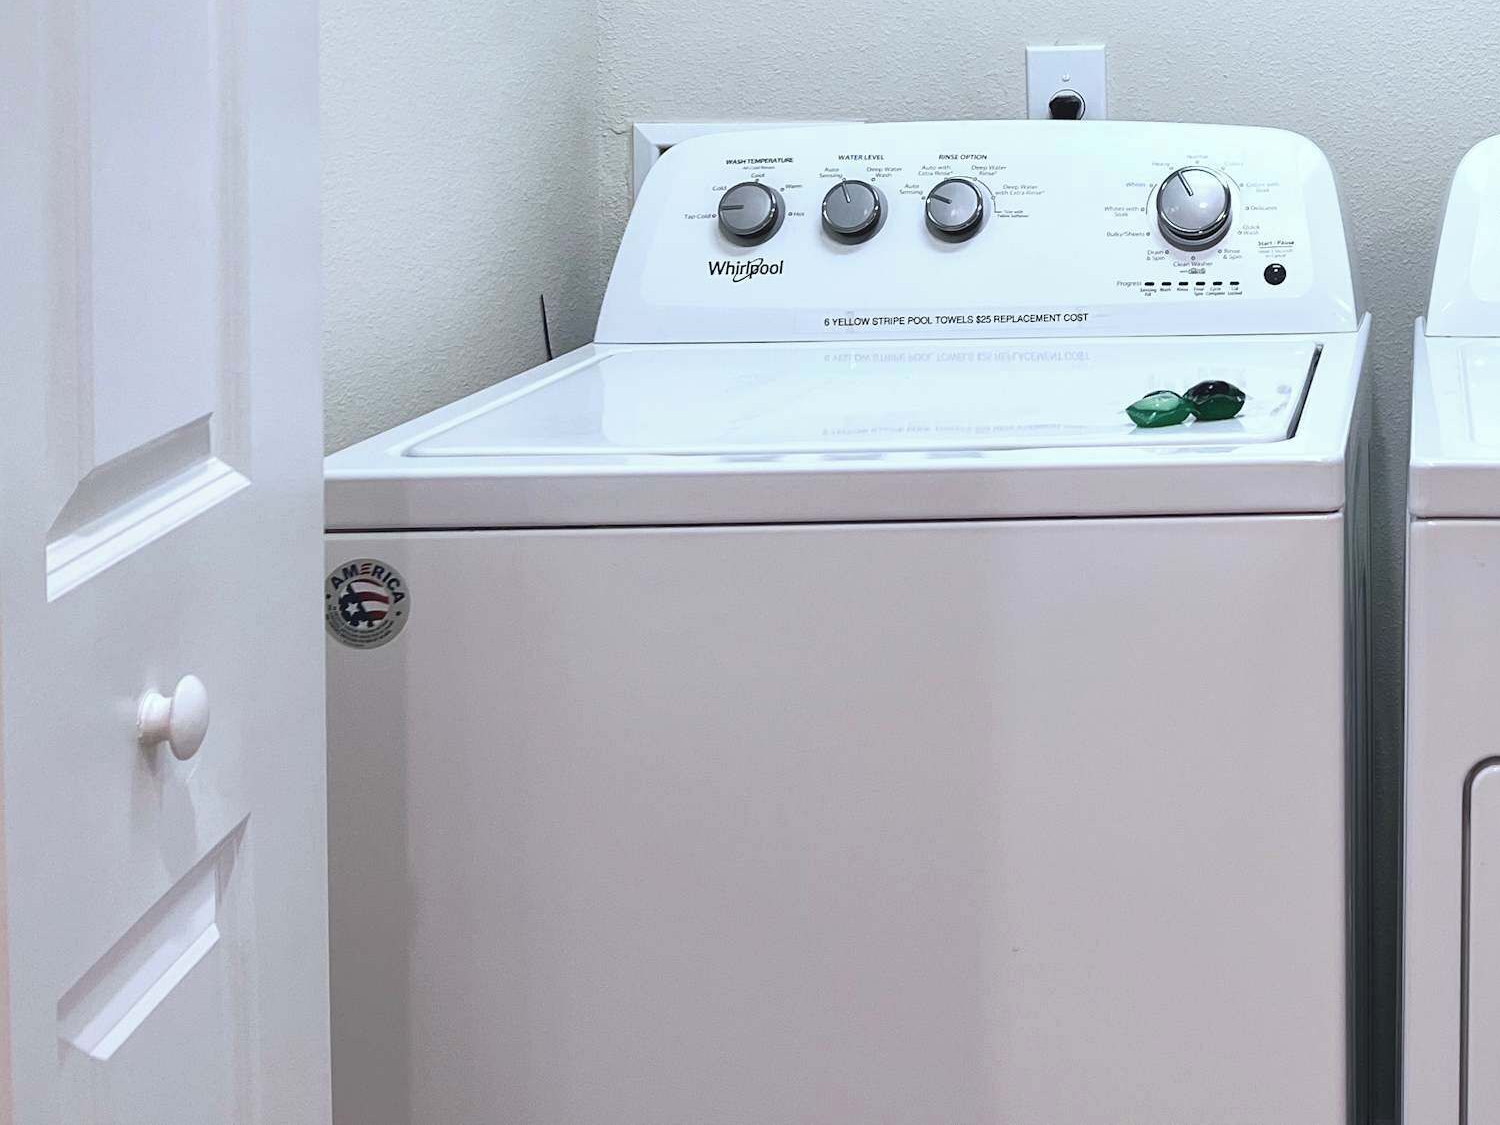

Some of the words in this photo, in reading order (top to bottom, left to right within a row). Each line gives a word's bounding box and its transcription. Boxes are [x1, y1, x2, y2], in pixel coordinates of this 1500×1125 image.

[746, 157, 794, 165] TEMPERATURE
[708, 257, 784, 282] Whirlpool
[823, 317, 830, 326] 6
[832, 317, 870, 326] YELLOW
[872, 317, 905, 326] STRIPE
[907, 316, 933, 325] POOL
[935, 315, 974, 325] TOWELS
[976, 314, 992, 324] $25
[994, 313, 1061, 323] REPLACEMENT
[1063, 313, 1088, 322] COST
[331, 562, 406, 604] AMERICA
